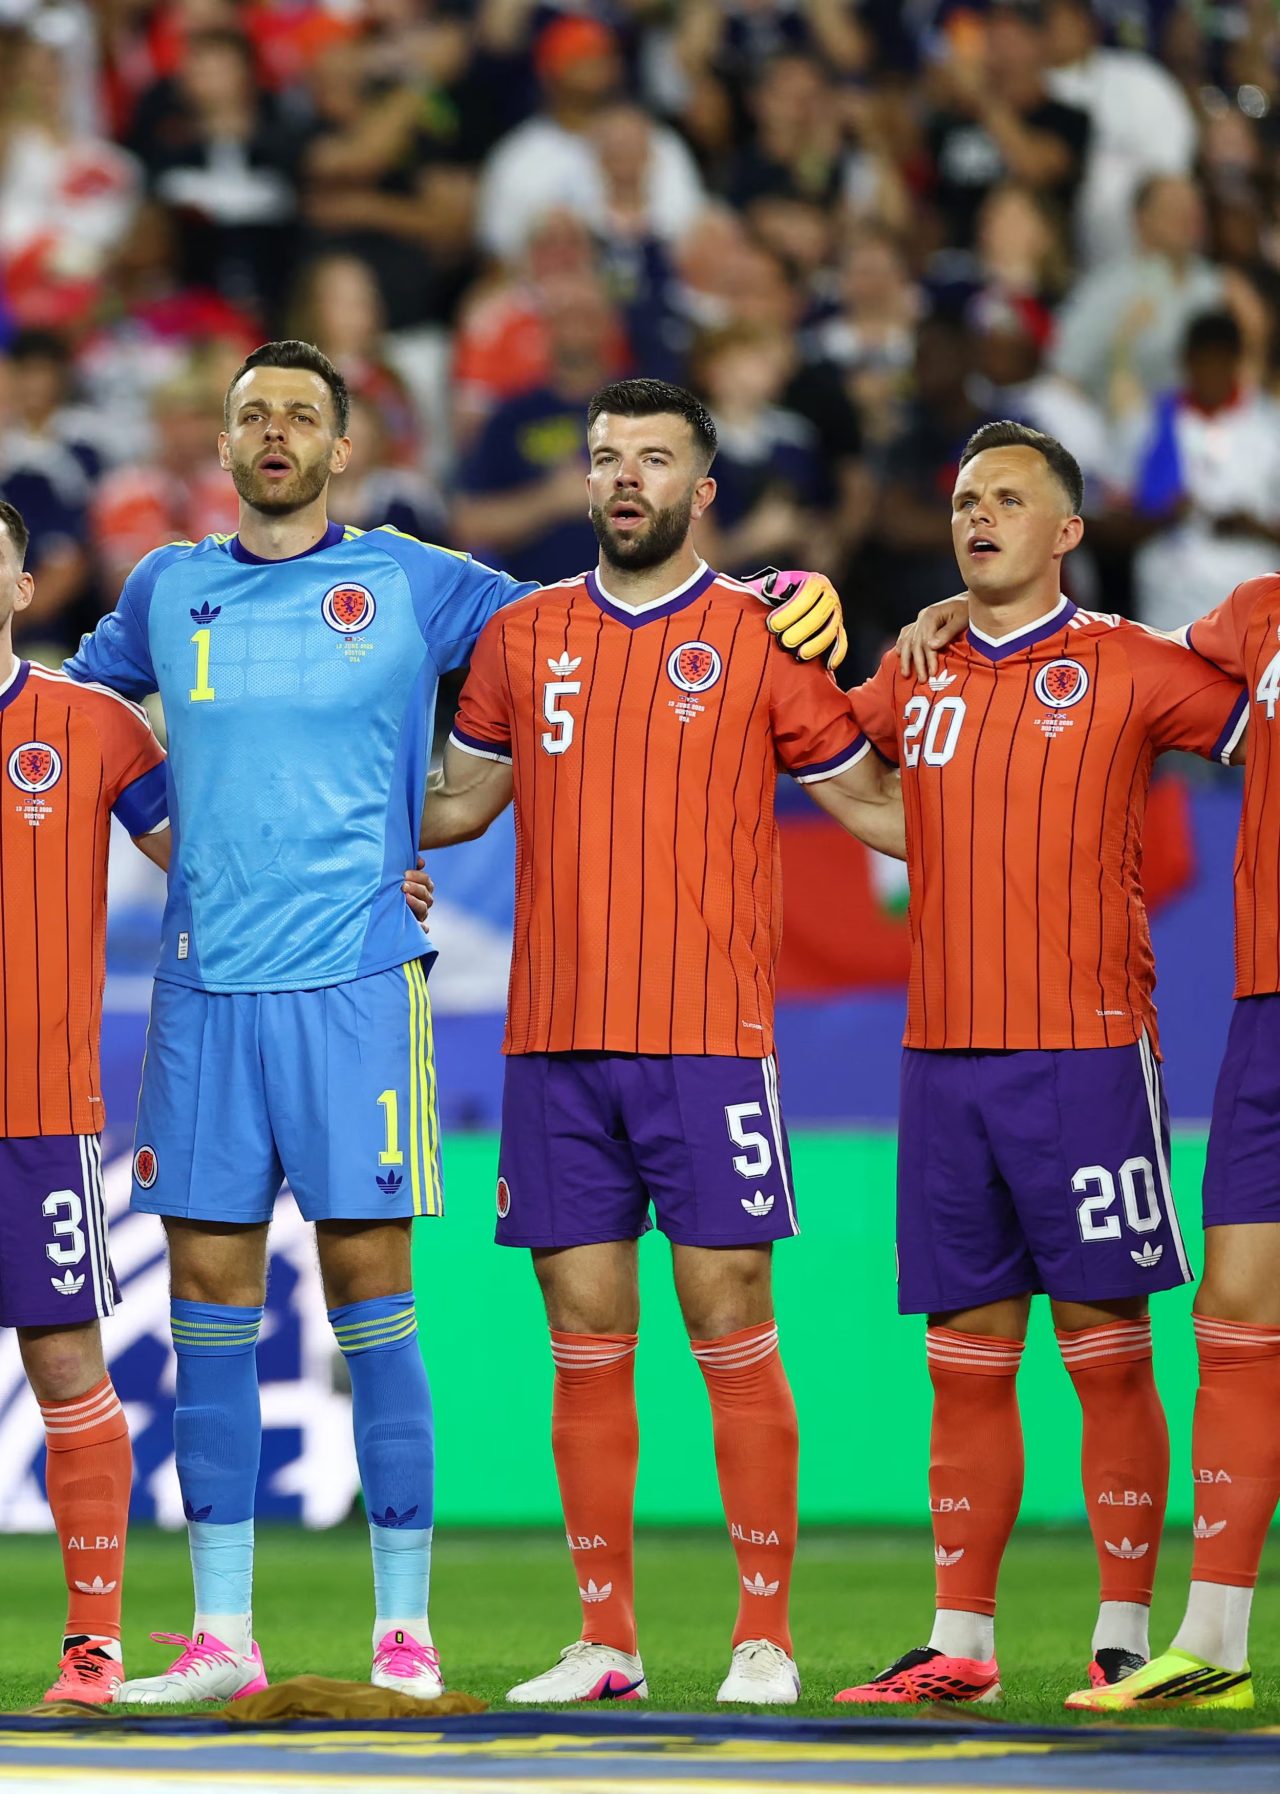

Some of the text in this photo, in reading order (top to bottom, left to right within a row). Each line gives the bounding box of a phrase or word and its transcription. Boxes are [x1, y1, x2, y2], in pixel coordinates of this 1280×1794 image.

[189, 628, 215, 704] 1
[541, 681, 581, 756] 5
[902, 695, 967, 768] 20
[376, 1089, 404, 1167] 1
[724, 1101, 772, 1180] 5
[42, 1189, 86, 1267] 3
[1070, 1155, 1162, 1243] 20
[928, 1496, 971, 1513] LBA
[1097, 1490, 1153, 1507] ALBA
[1192, 1469, 1233, 1484] LBA
[67, 1535, 119, 1550] ALBA
[731, 1522, 780, 1546] ALBA
